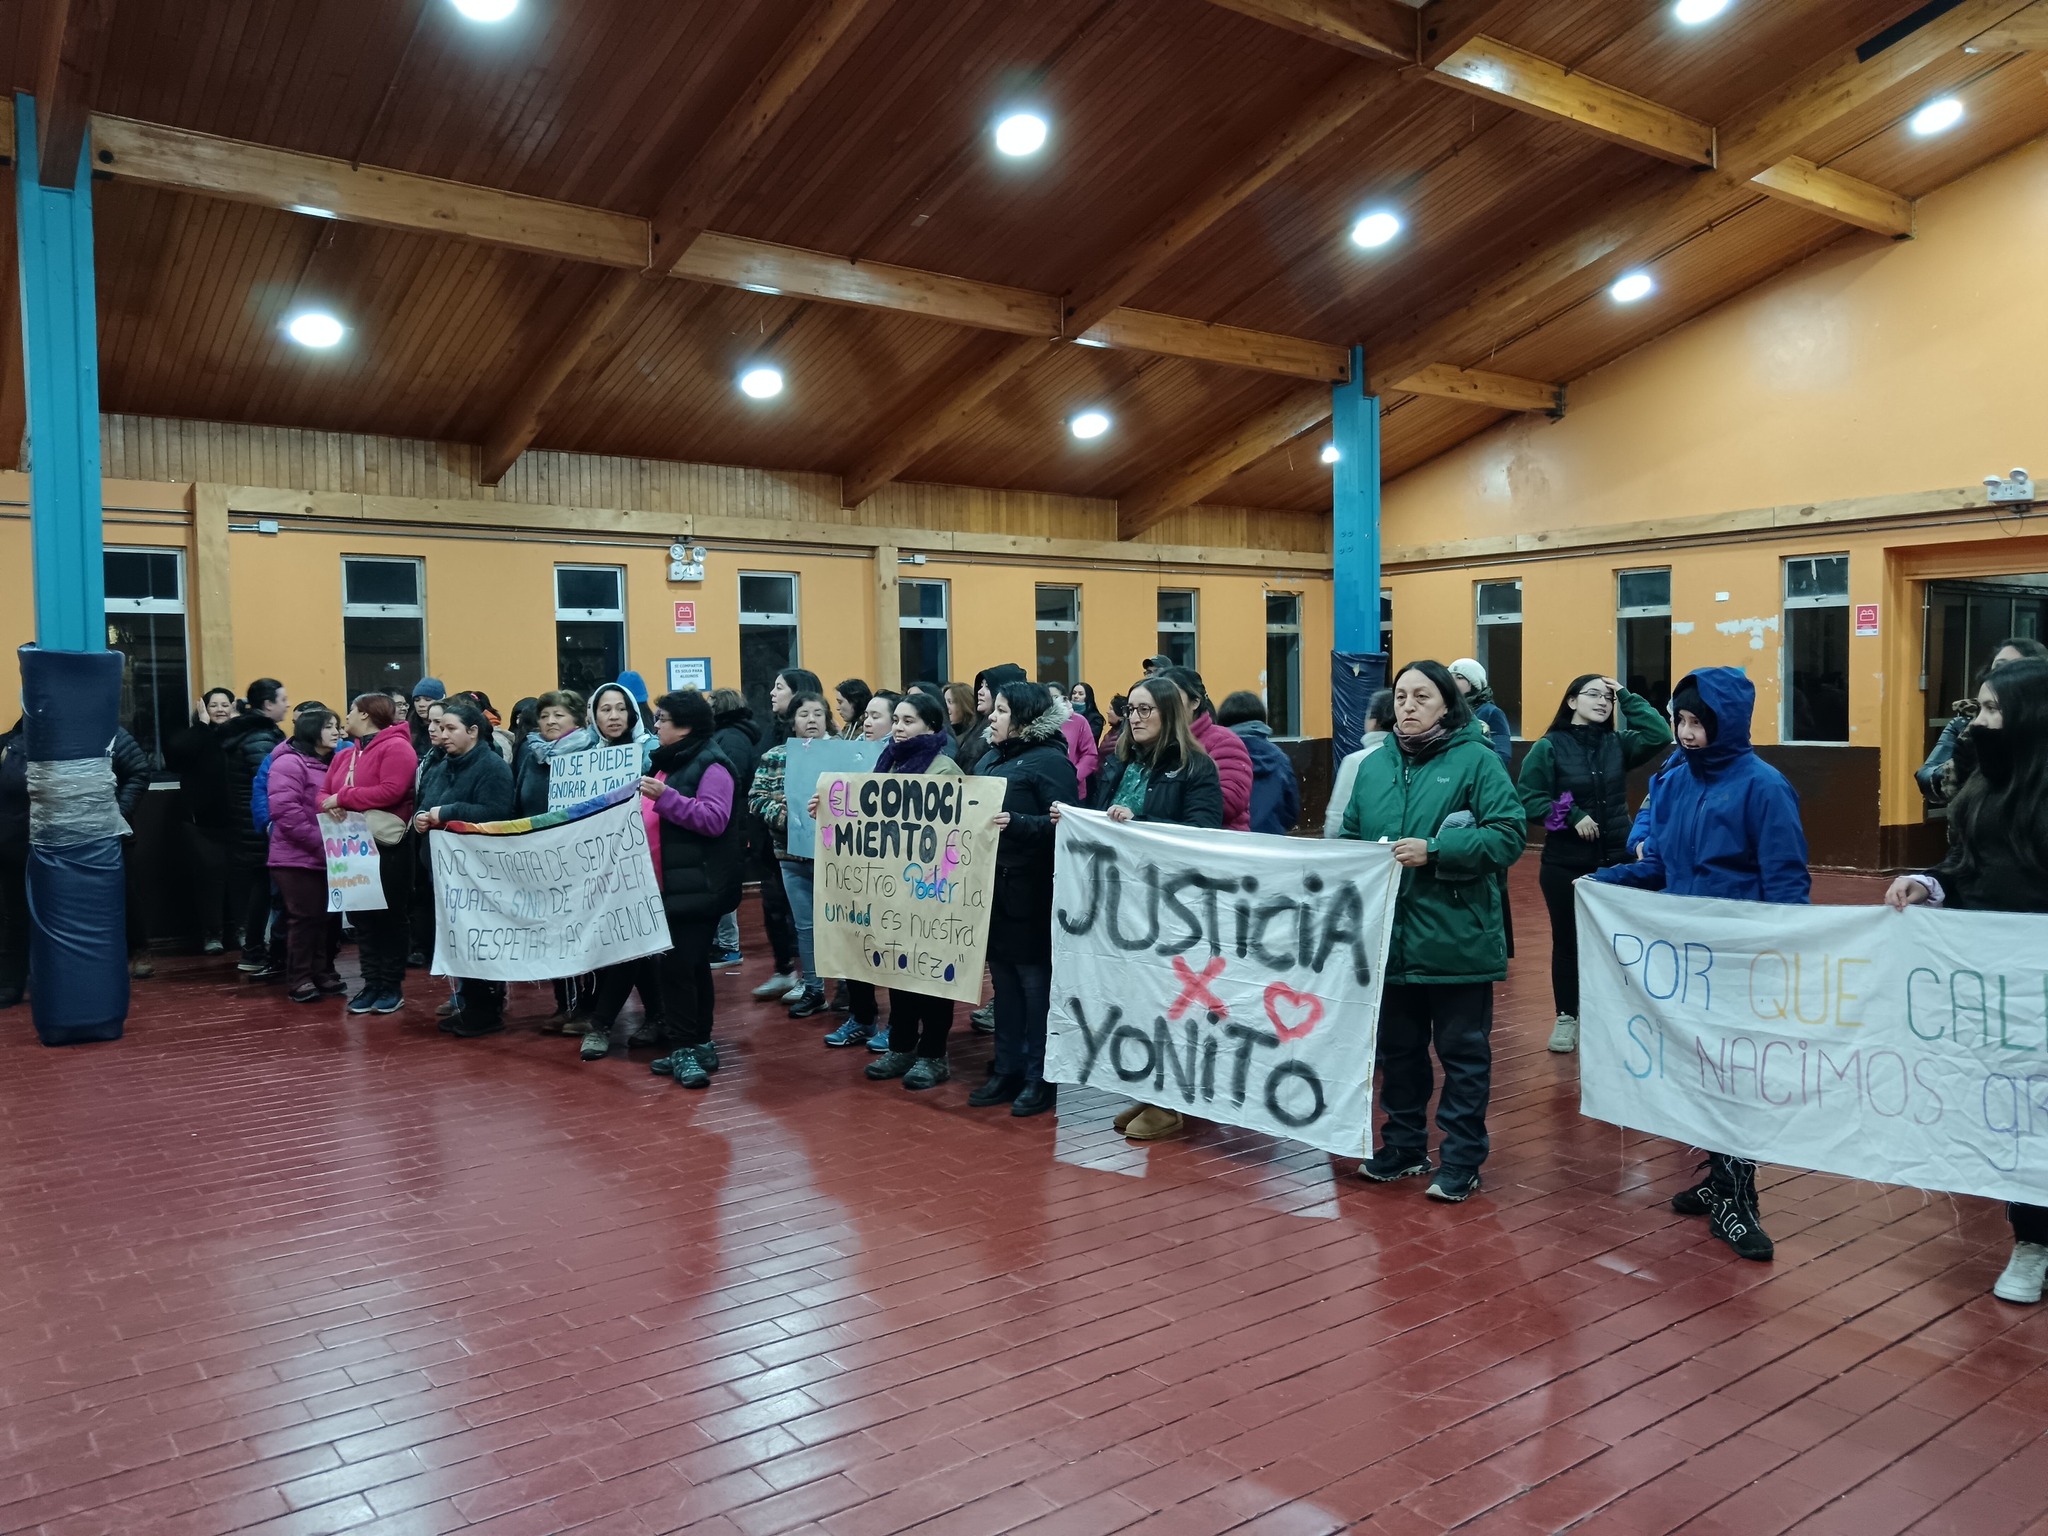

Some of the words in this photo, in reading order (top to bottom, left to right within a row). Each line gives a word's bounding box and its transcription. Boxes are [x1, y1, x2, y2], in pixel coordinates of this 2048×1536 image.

[551, 757, 566, 778] NO
[568, 755, 583, 776] SE
[589, 747, 633, 774] PUEDE
[590, 780, 598, 795] A
[602, 772, 639, 793] TANT
[828, 779, 859, 818] EL
[437, 849, 468, 878] NO
[475, 849, 501, 881] SE
[494, 850, 548, 883] TRATA
[544, 846, 576, 881] DE
[575, 836, 604, 873] SER
[549, 883, 573, 914] DE
[448, 929, 458, 960] A
[468, 927, 548, 961] RESPETAR
[1167, 955, 1229, 1020] X
[1612, 932, 1714, 1011] POR
[1749, 948, 1872, 1028] QUE
[1907, 967, 2048, 1053] CAL
